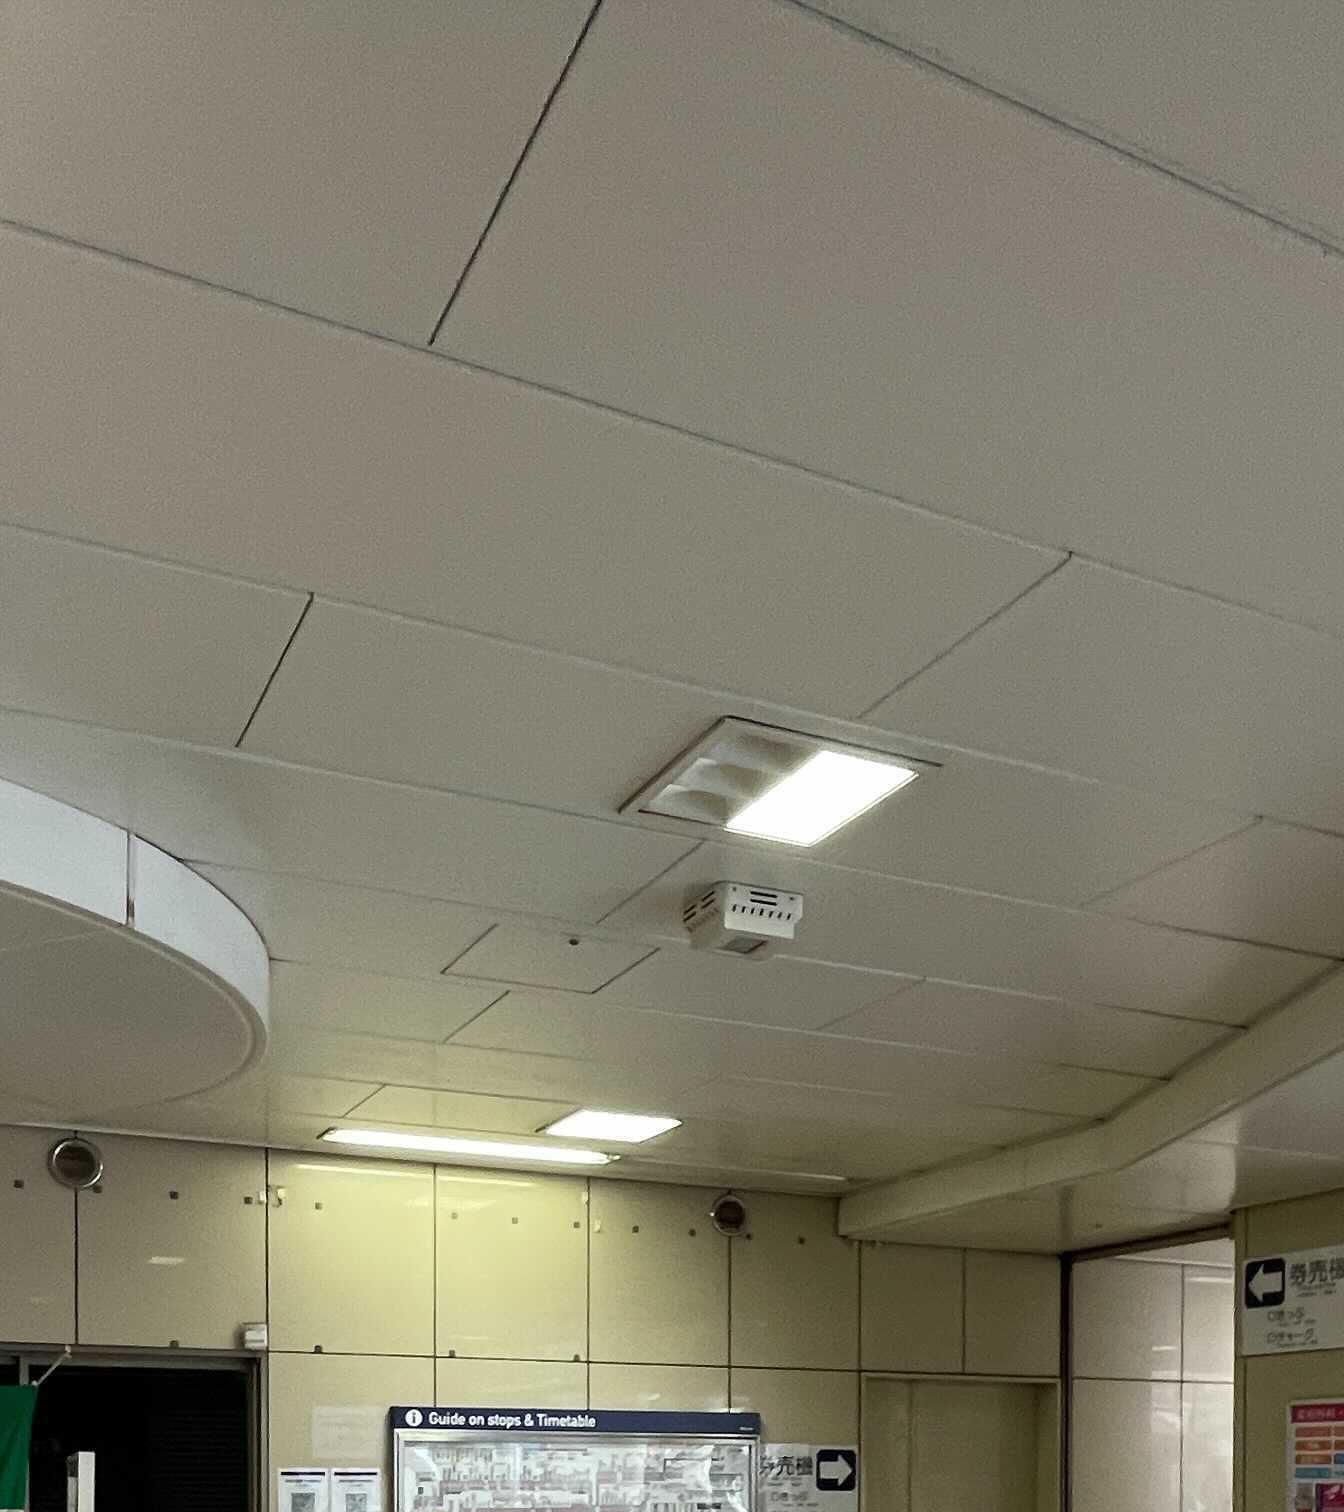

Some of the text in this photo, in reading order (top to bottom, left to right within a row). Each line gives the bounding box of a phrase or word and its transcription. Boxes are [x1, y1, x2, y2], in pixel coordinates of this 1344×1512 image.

[428, 1411, 596, 1429] Guide on stops & Timetable
